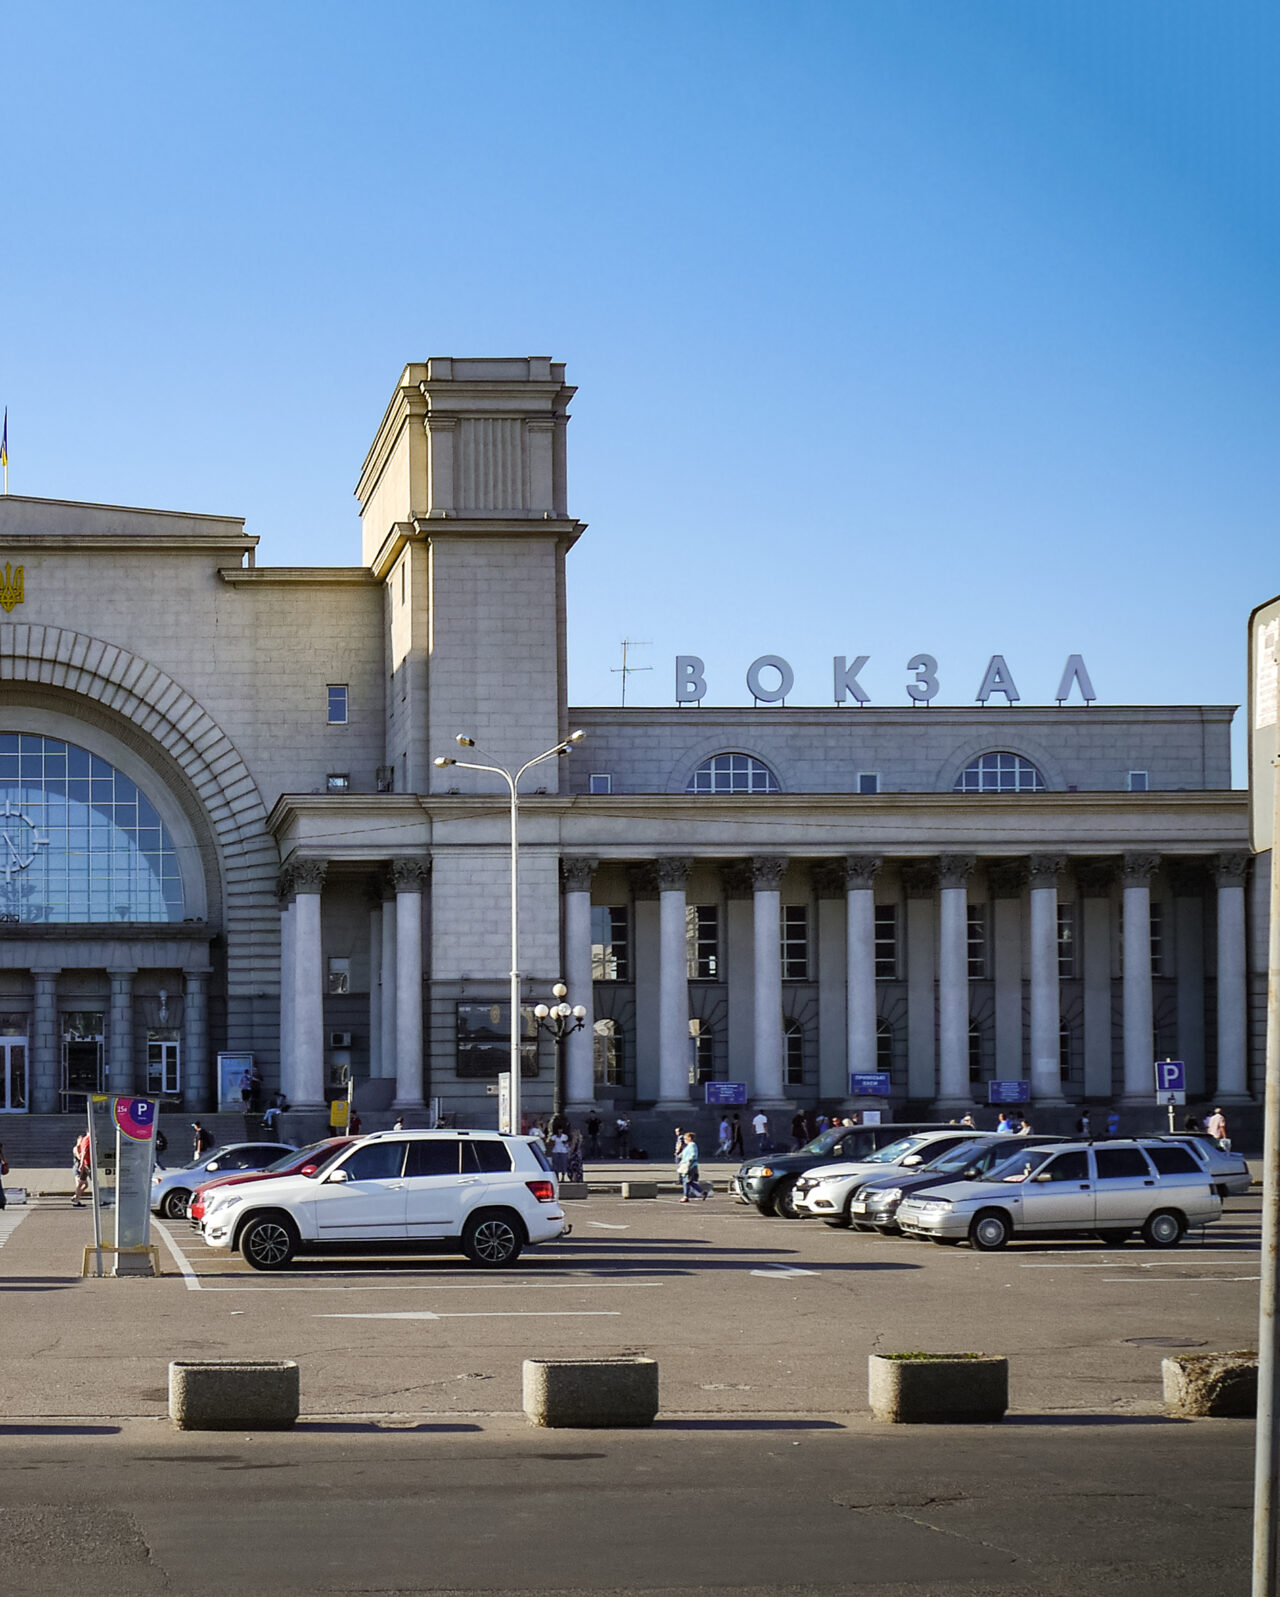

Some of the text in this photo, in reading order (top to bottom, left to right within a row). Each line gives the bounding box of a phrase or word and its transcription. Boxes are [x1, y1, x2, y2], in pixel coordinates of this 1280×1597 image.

[675, 653, 1097, 703] ВОКЗАЛ
[1163, 1065, 1179, 1088] P
[137, 1103, 147, 1115] P
